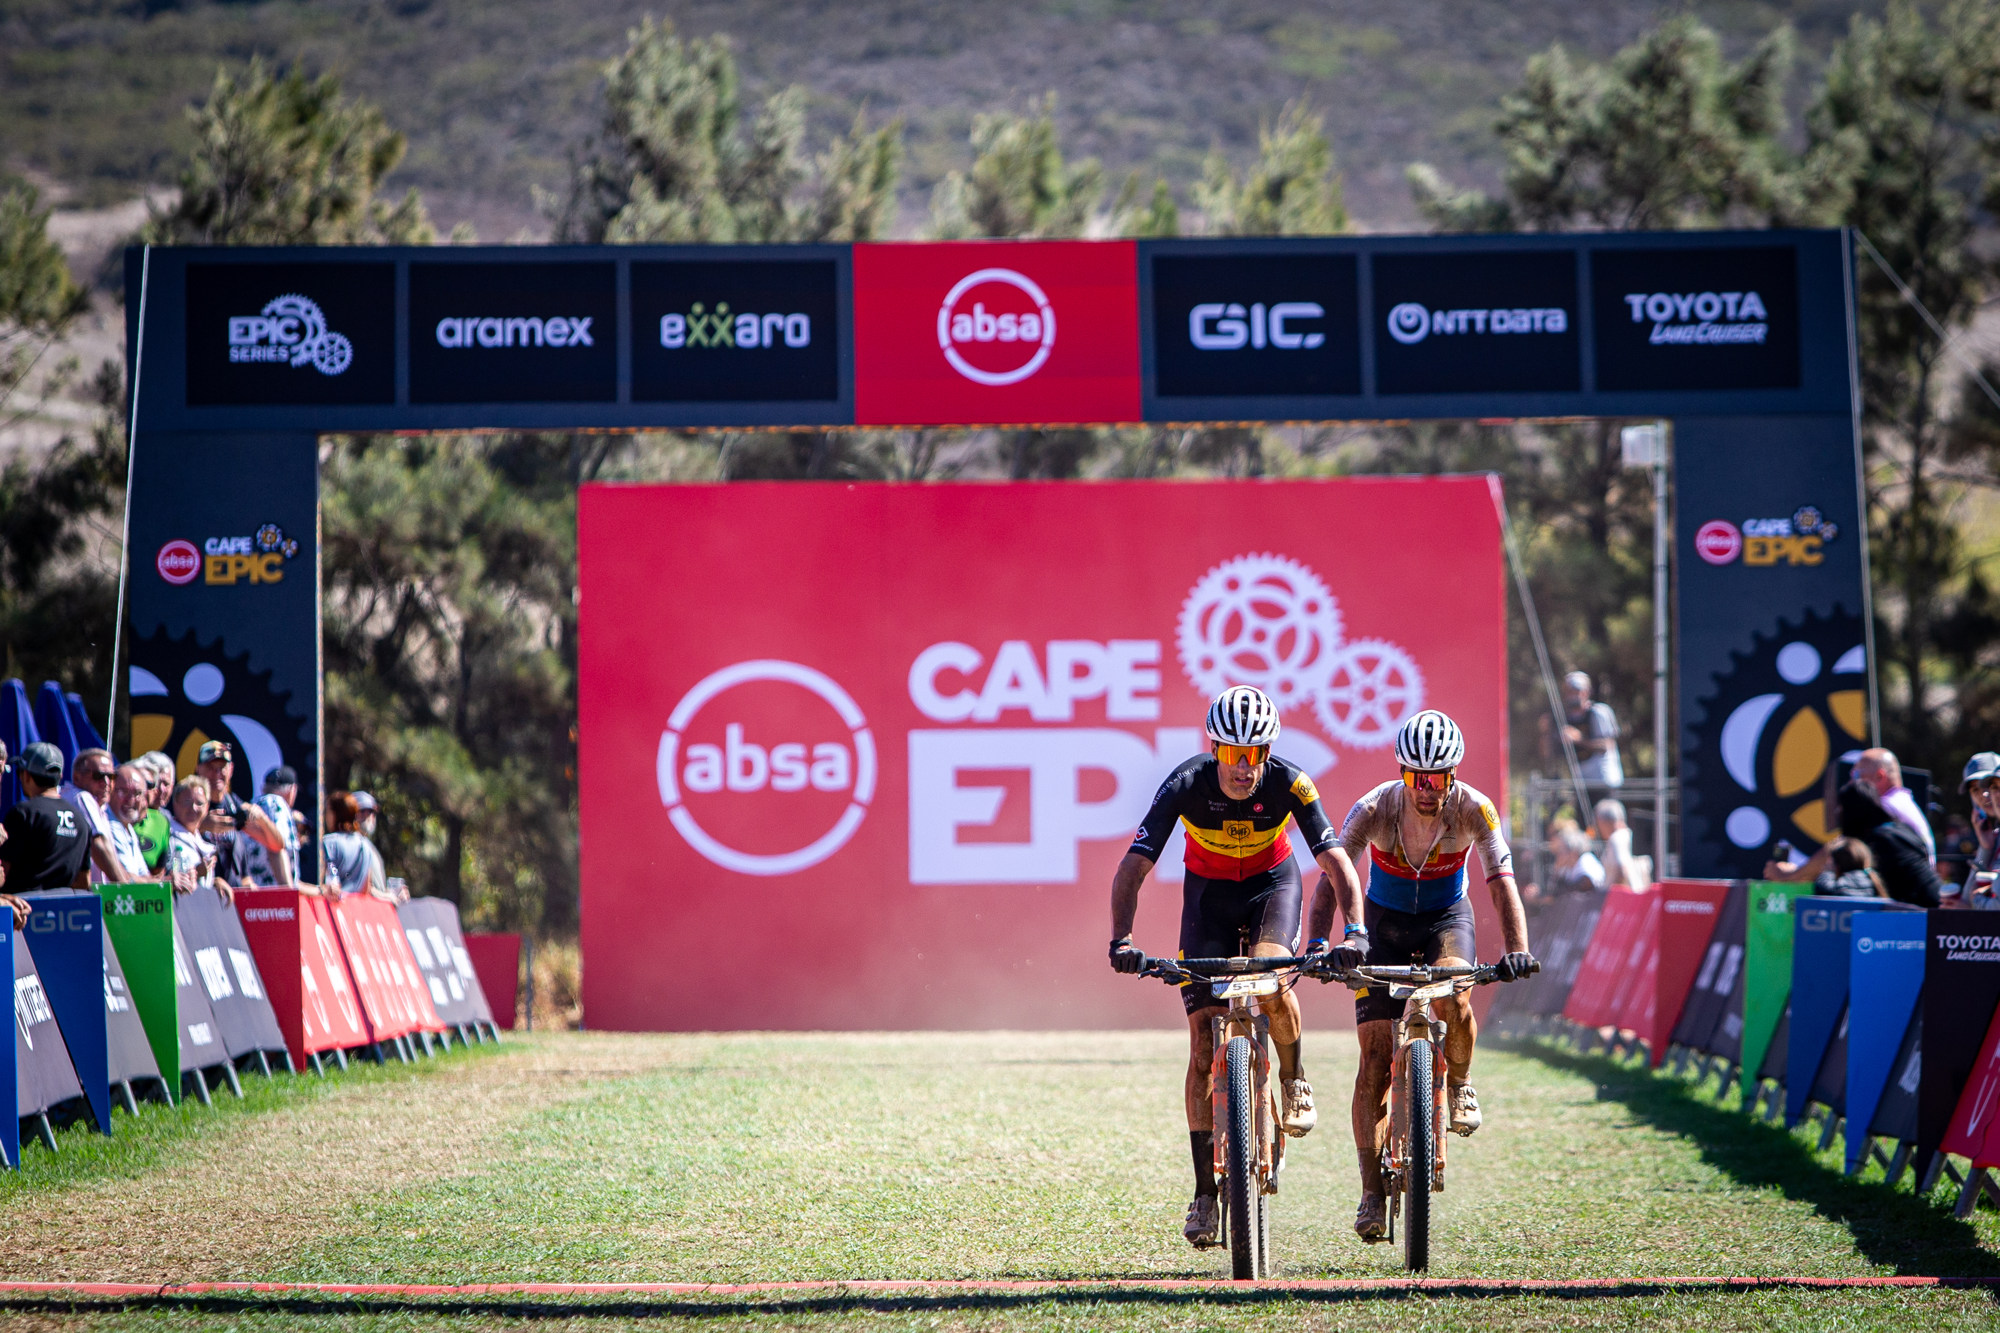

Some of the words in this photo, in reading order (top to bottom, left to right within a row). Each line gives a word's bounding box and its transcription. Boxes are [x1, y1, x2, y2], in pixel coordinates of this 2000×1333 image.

[1625, 291, 1768, 322] TOYOTA
[229, 316, 300, 345] EPIC
[436, 316, 594, 347] aramex
[660, 302, 811, 348] exxaro
[950, 302, 1042, 343] absa
[1189, 302, 1325, 349] GIC
[1432, 309, 1490, 334] NTT
[229, 345, 290, 364] SERIES
[1741, 518, 1793, 537] CAPE
[205, 536, 253, 556] CAPE
[1743, 534, 1824, 566] EPIC
[205, 552, 284, 585] EPIC
[685, 723, 852, 793] absa
[909, 640, 1162, 722] CAPE
[104, 893, 165, 917] exxaro
[244, 906, 296, 922] aramex
[30, 910, 93, 933] GIC
[1936, 934, 2000, 951] TOYOTA
